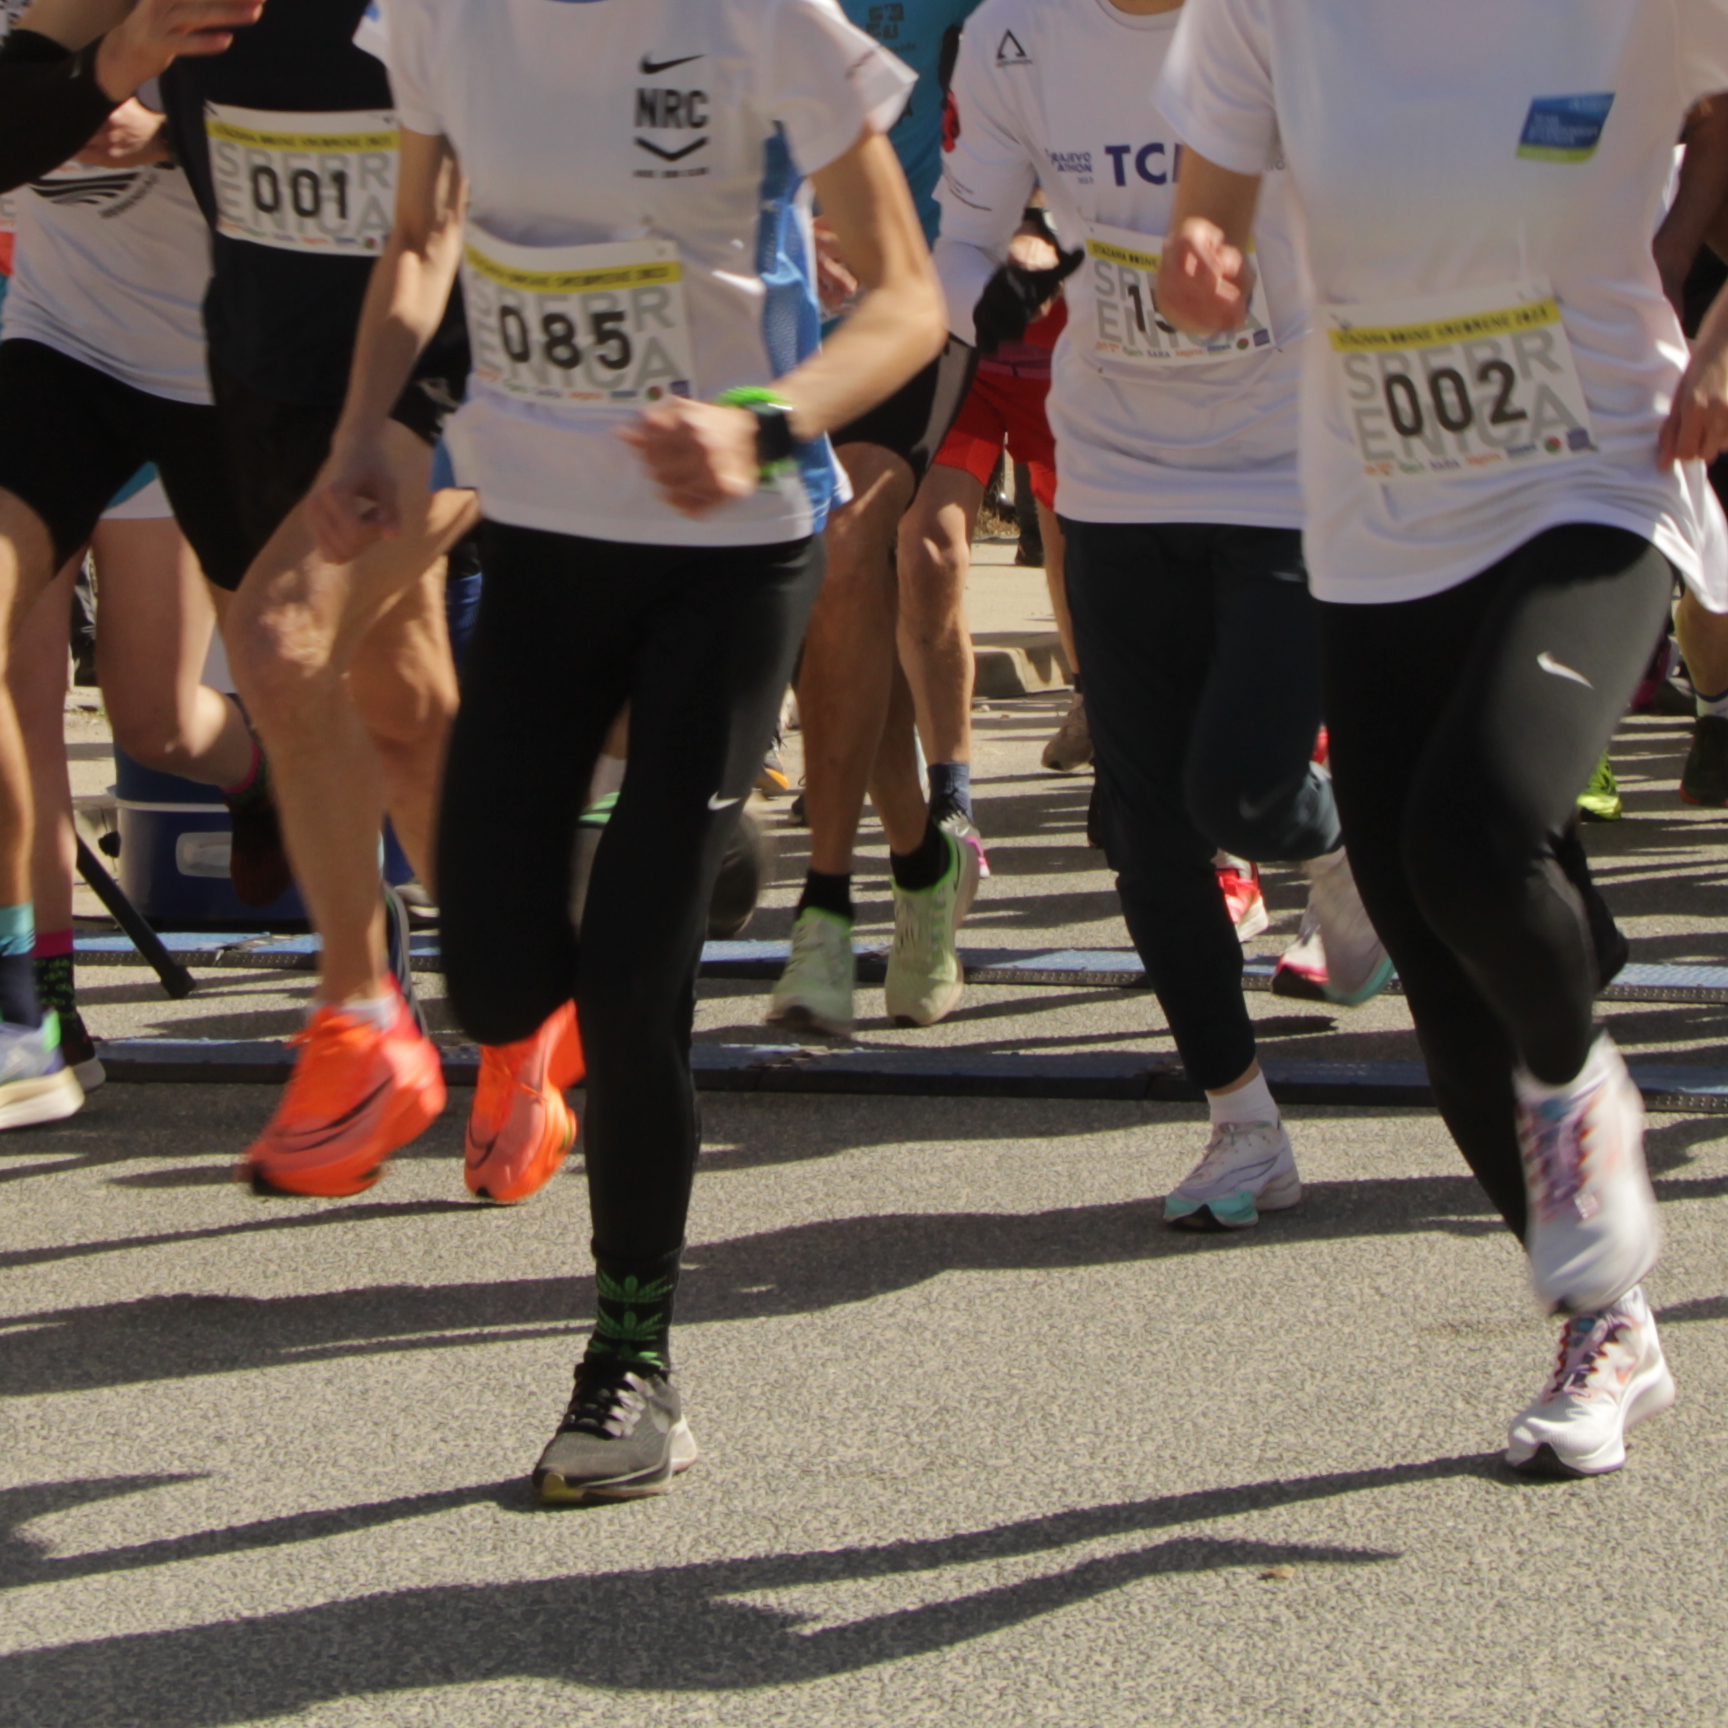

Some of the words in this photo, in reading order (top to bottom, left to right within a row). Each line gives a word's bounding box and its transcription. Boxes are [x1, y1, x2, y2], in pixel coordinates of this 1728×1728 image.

[634, 88, 709, 128] NRC
[252, 165, 347, 220] 001
[500, 305, 632, 370] 085
[1385, 360, 1527, 437] 002
